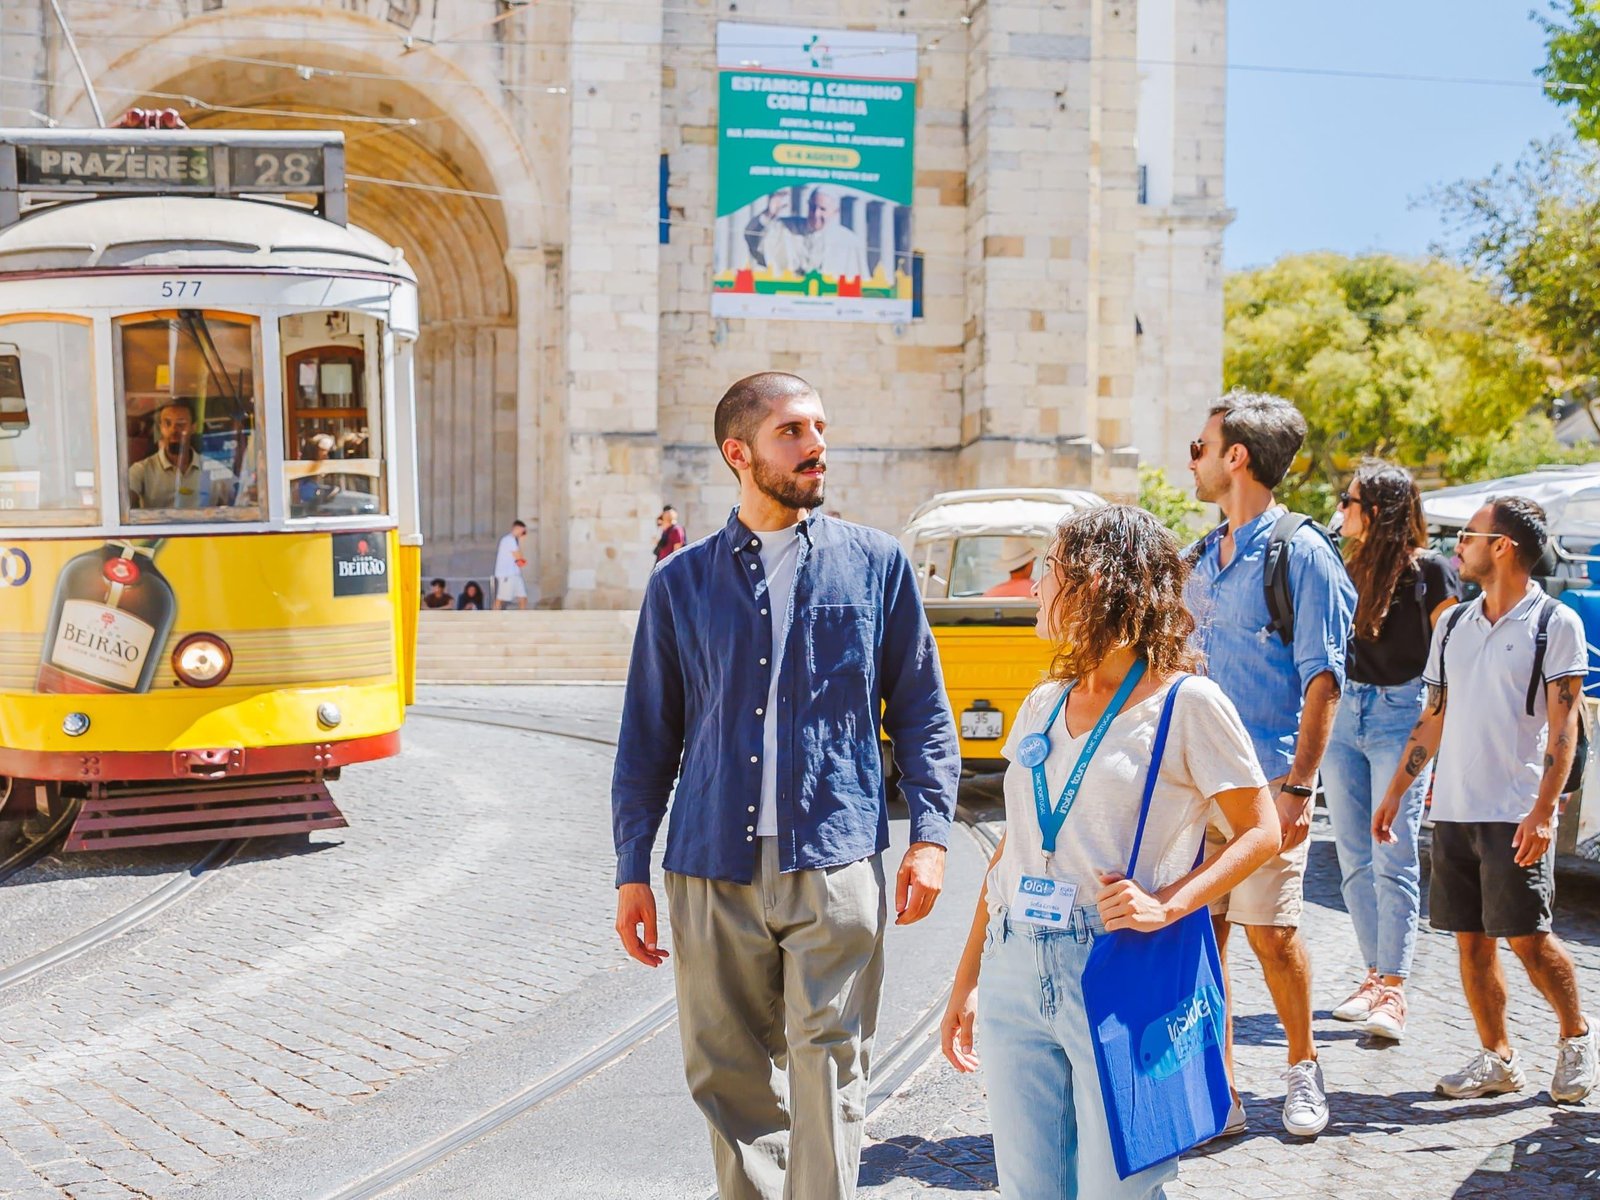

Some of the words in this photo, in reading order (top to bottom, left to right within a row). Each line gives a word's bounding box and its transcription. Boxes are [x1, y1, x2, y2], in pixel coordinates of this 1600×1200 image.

[731, 76, 811, 95] ESTAMOS
[812, 81, 825, 96] A
[826, 82, 903, 101] CAMINHO
[766, 93, 808, 111] COM
[809, 97, 868, 116] MARIA
[40, 149, 209, 180] PRAZERES
[254, 152, 312, 186] 28
[161, 281, 202, 298] 577
[338, 558, 386, 577] BEIRÃO
[63, 622, 139, 662] BEIRÃO
[974, 712, 989, 724] 35
[1086, 740, 1096, 753] DMC
[1093, 712, 1113, 740] PORTUGAL
[1057, 788, 1075, 815] inside
[1023, 880, 1048, 894] Olá!
[1165, 997, 1211, 1042] inside
